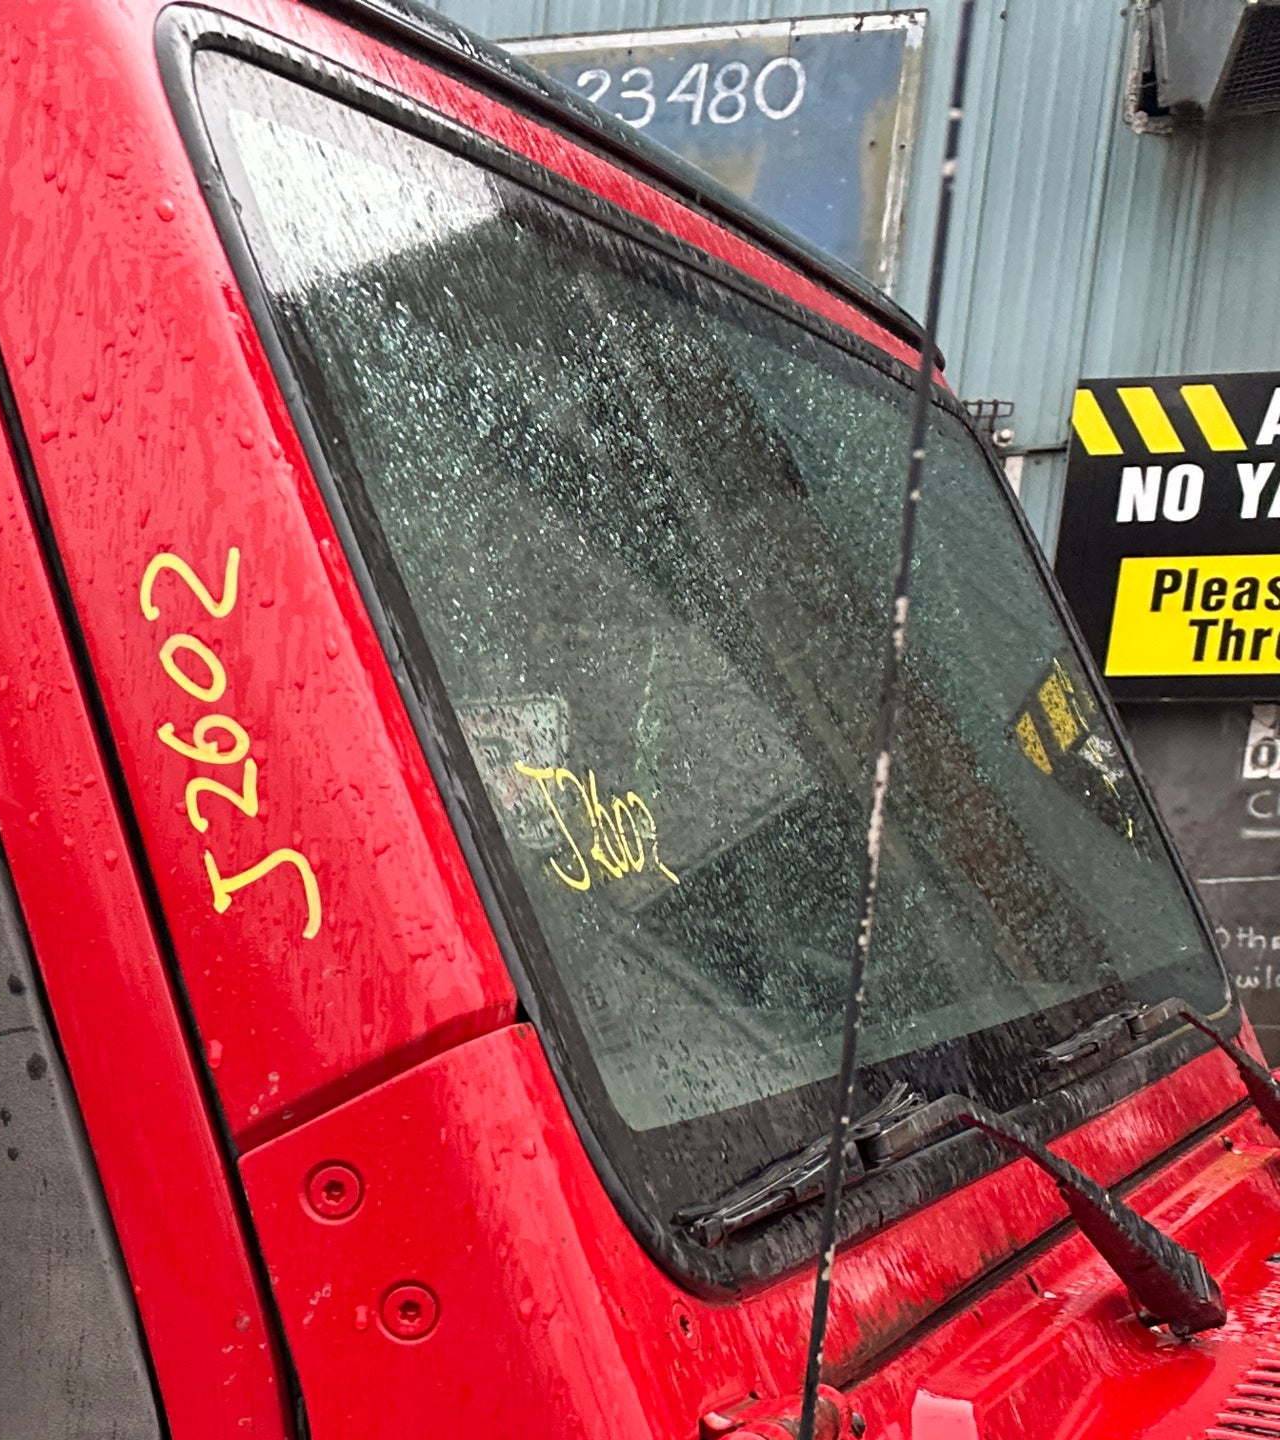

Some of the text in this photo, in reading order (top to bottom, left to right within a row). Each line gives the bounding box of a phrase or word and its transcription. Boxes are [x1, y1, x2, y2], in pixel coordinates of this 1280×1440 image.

[576, 56, 806, 129] 23480
[1116, 462, 1280, 522] NO Y
[140, 547, 322, 939] J2602
